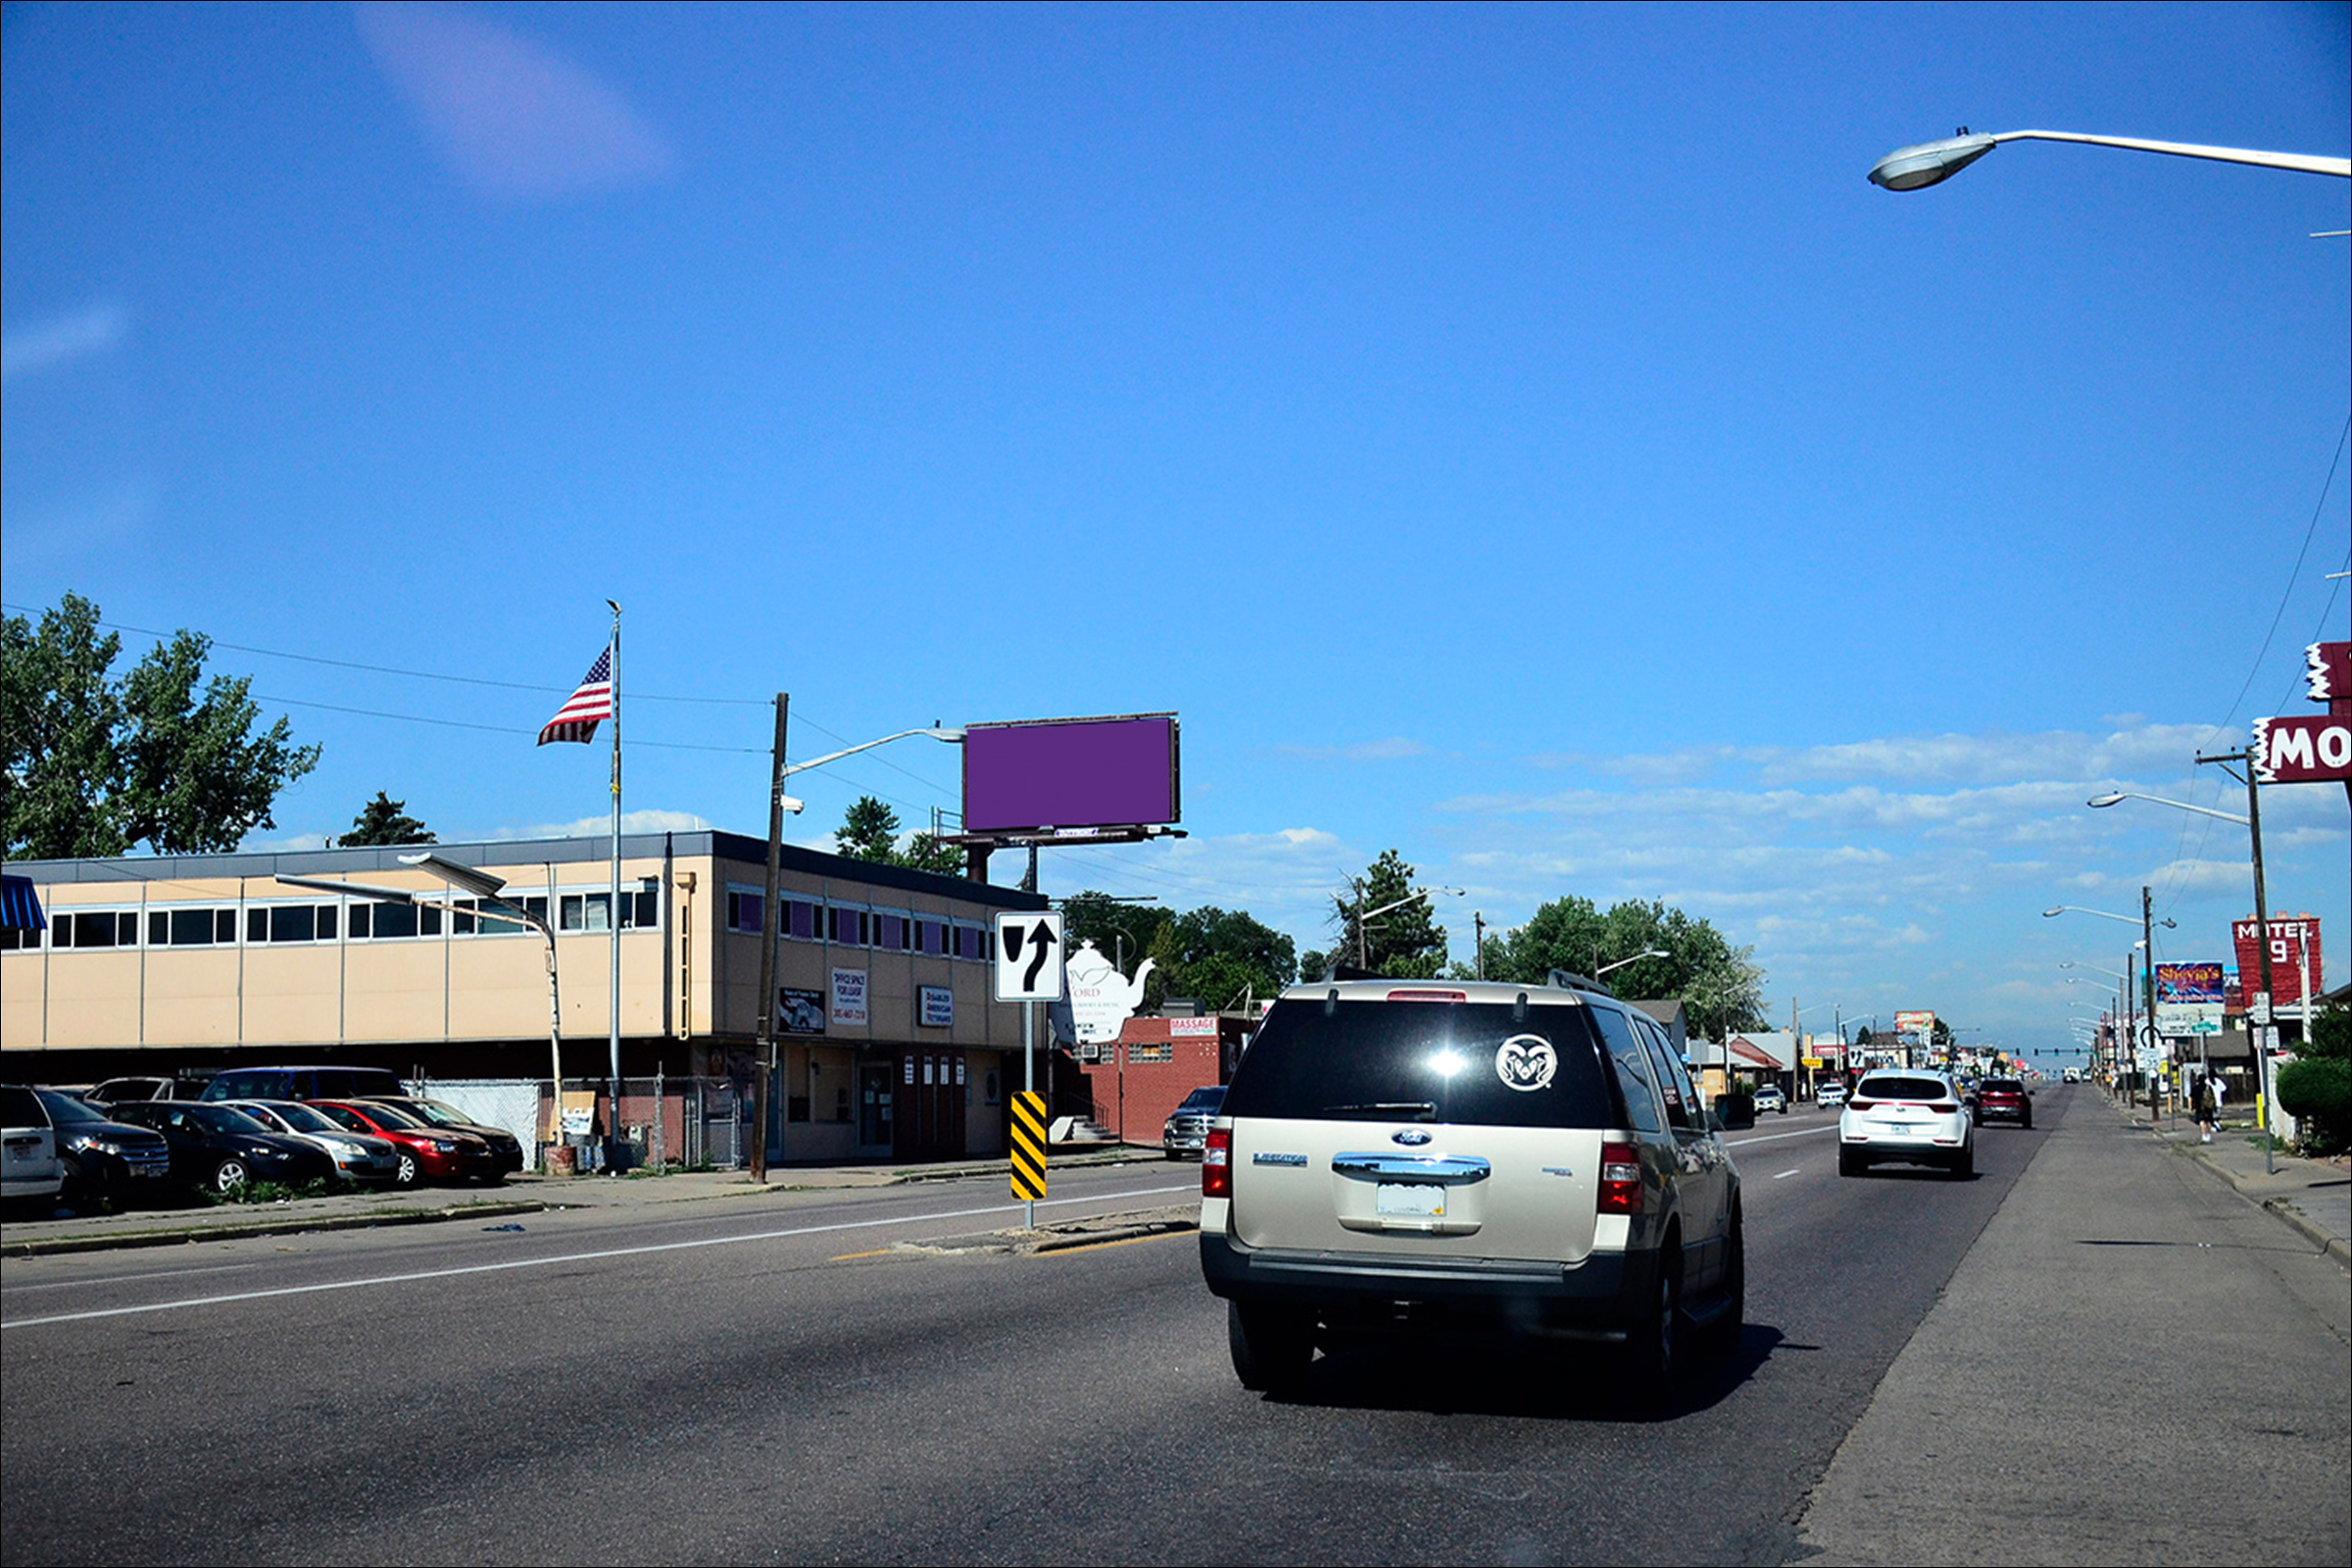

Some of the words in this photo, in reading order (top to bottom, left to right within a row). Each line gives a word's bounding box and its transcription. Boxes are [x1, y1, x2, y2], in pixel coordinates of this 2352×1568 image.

[2270, 726, 2351, 769] MO
[2237, 923, 2314, 939] MTE
[2270, 940, 2287, 962] 9
[1171, 1018, 1214, 1029] MASSAGE
